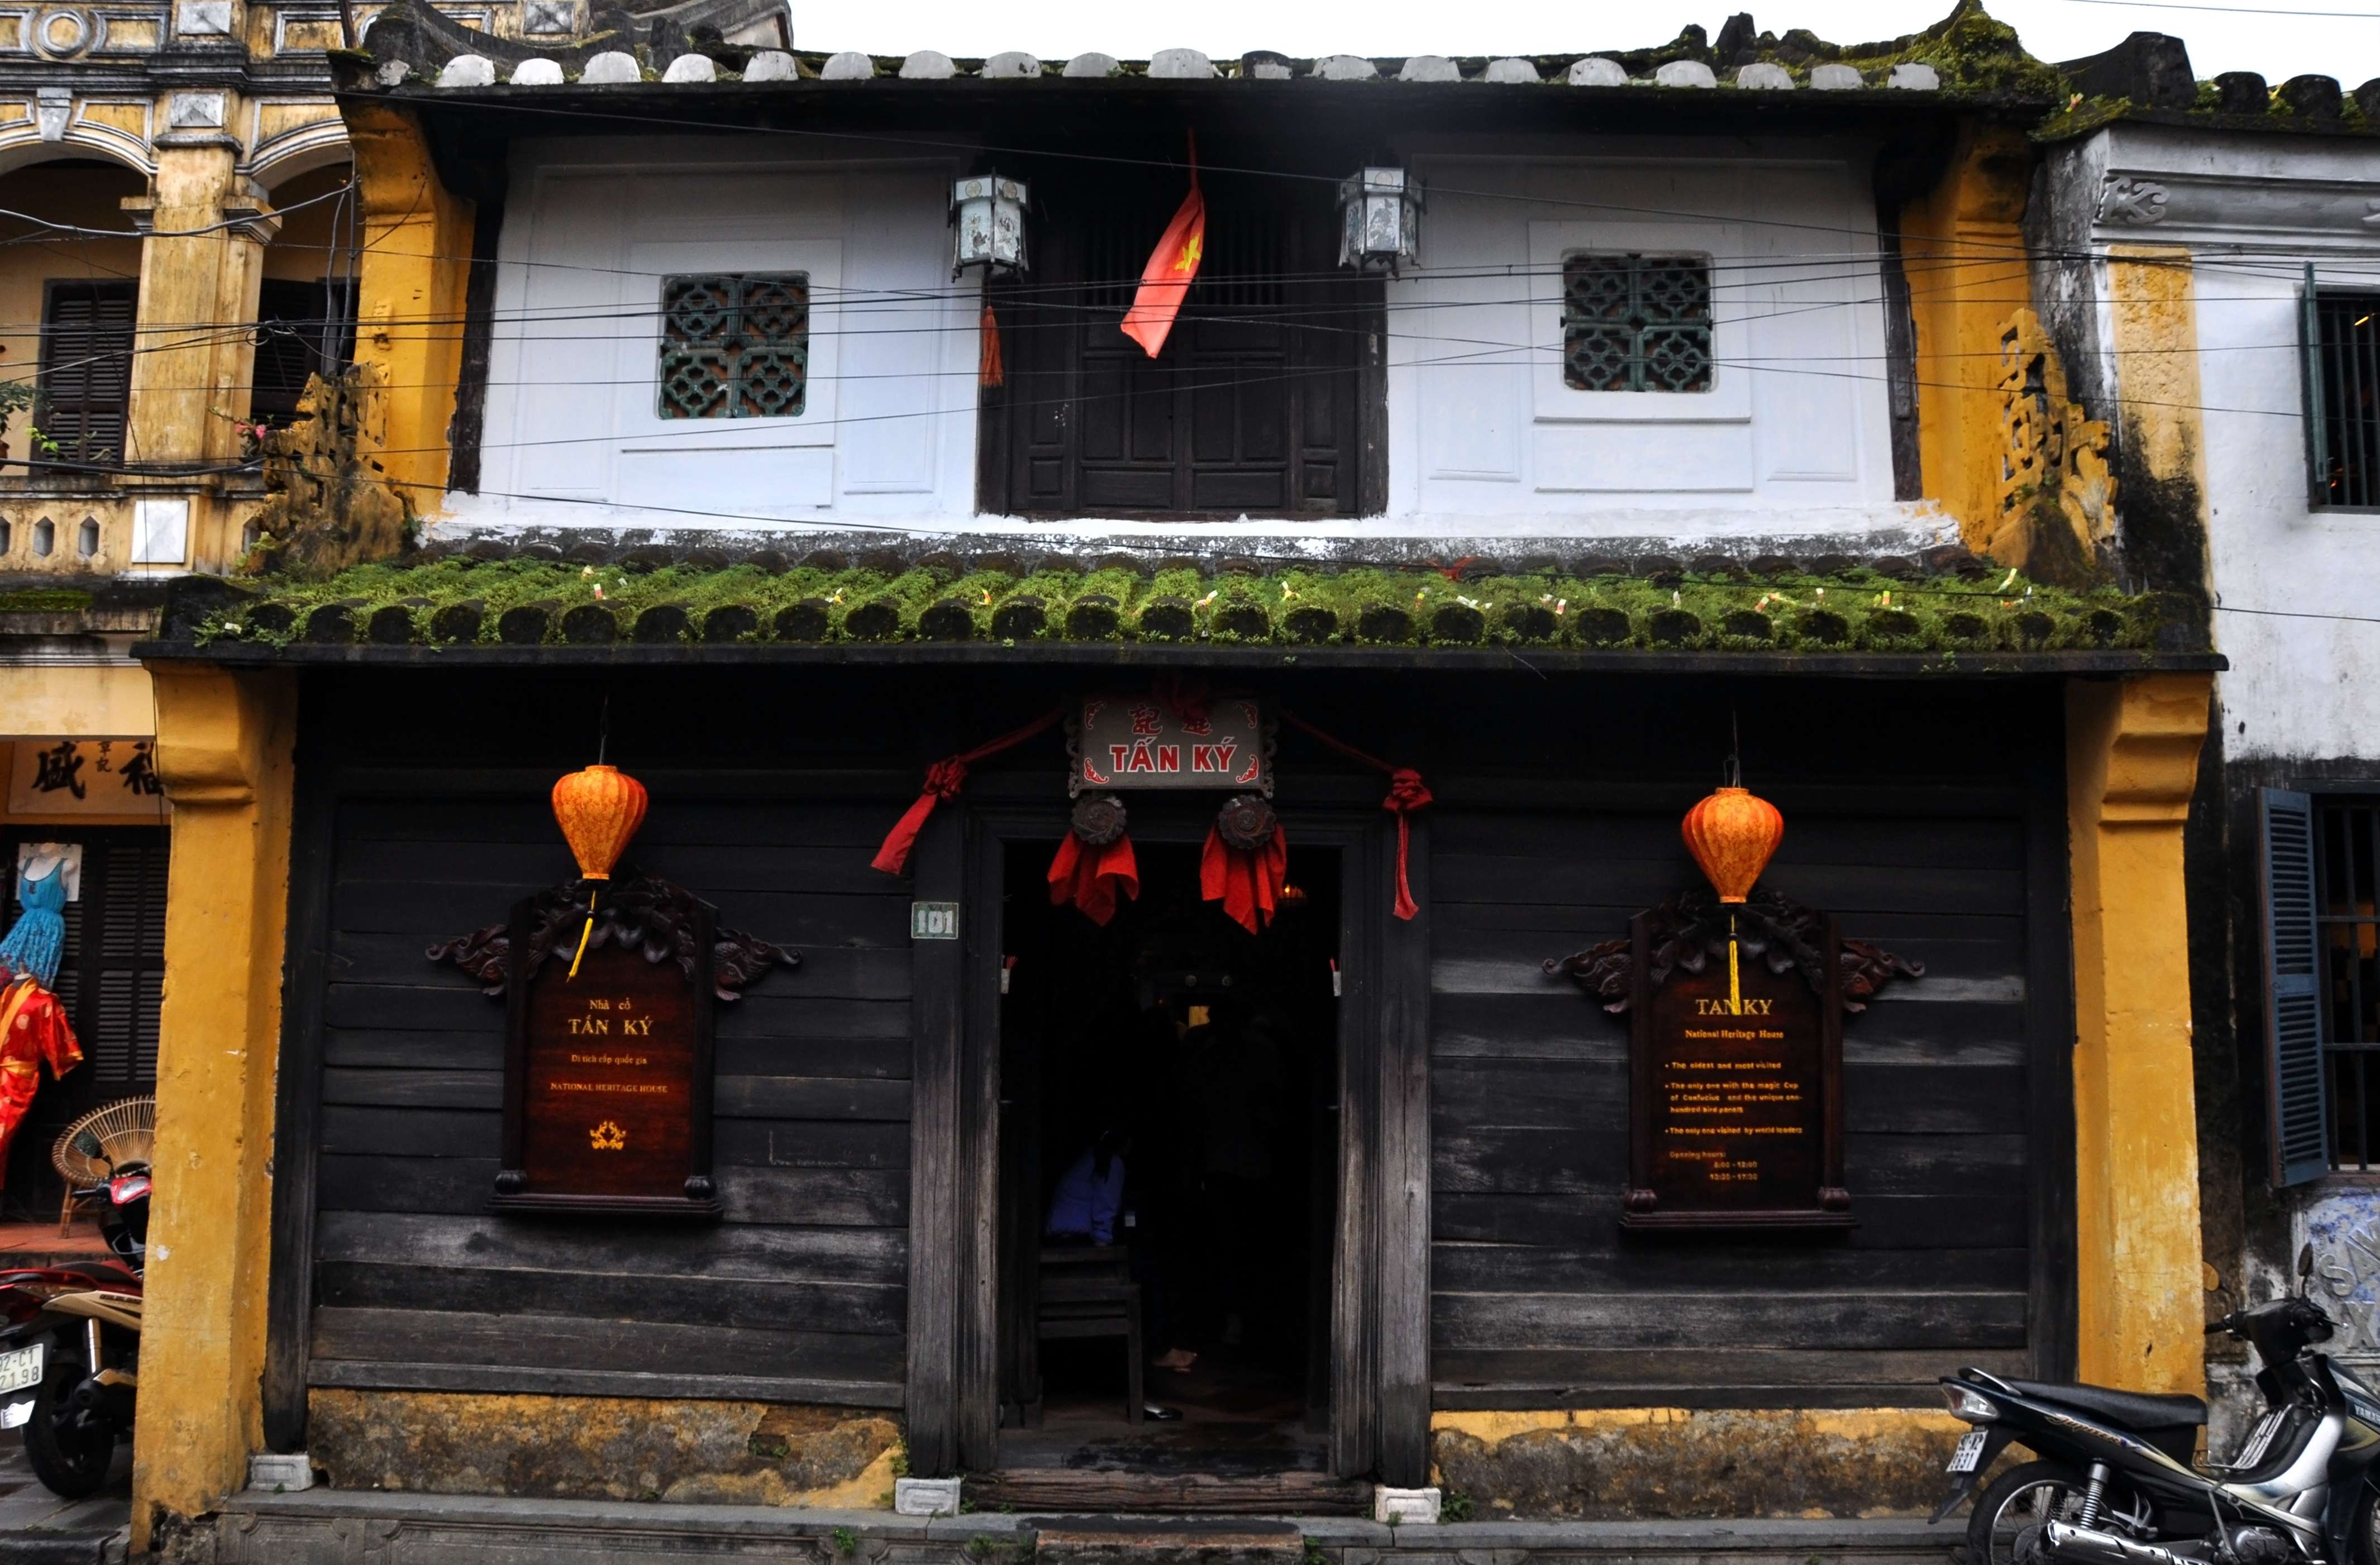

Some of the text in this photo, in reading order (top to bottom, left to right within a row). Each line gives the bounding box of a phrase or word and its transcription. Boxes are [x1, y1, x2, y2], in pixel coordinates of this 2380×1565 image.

[1110, 736, 1237, 772] TẤN KÝ
[918, 910, 953, 933] 101
[590, 998, 631, 1010] Nhà cổ
[1743, 999, 1772, 1015] KY
[568, 1015, 653, 1035] TẤN KÝ
[1685, 1030, 1719, 1038] National
[1721, 1030, 1756, 1040] Heritage
[1756, 1061, 1781, 1069] visited
[550, 1082, 594, 1091] NATIONAL
[596, 1084, 638, 1092] HERITAGE
[1723, 1081, 1739, 1090] with
[1758, 1081, 1781, 1090] magic
[1670, 1151, 1701, 1160] Opening
